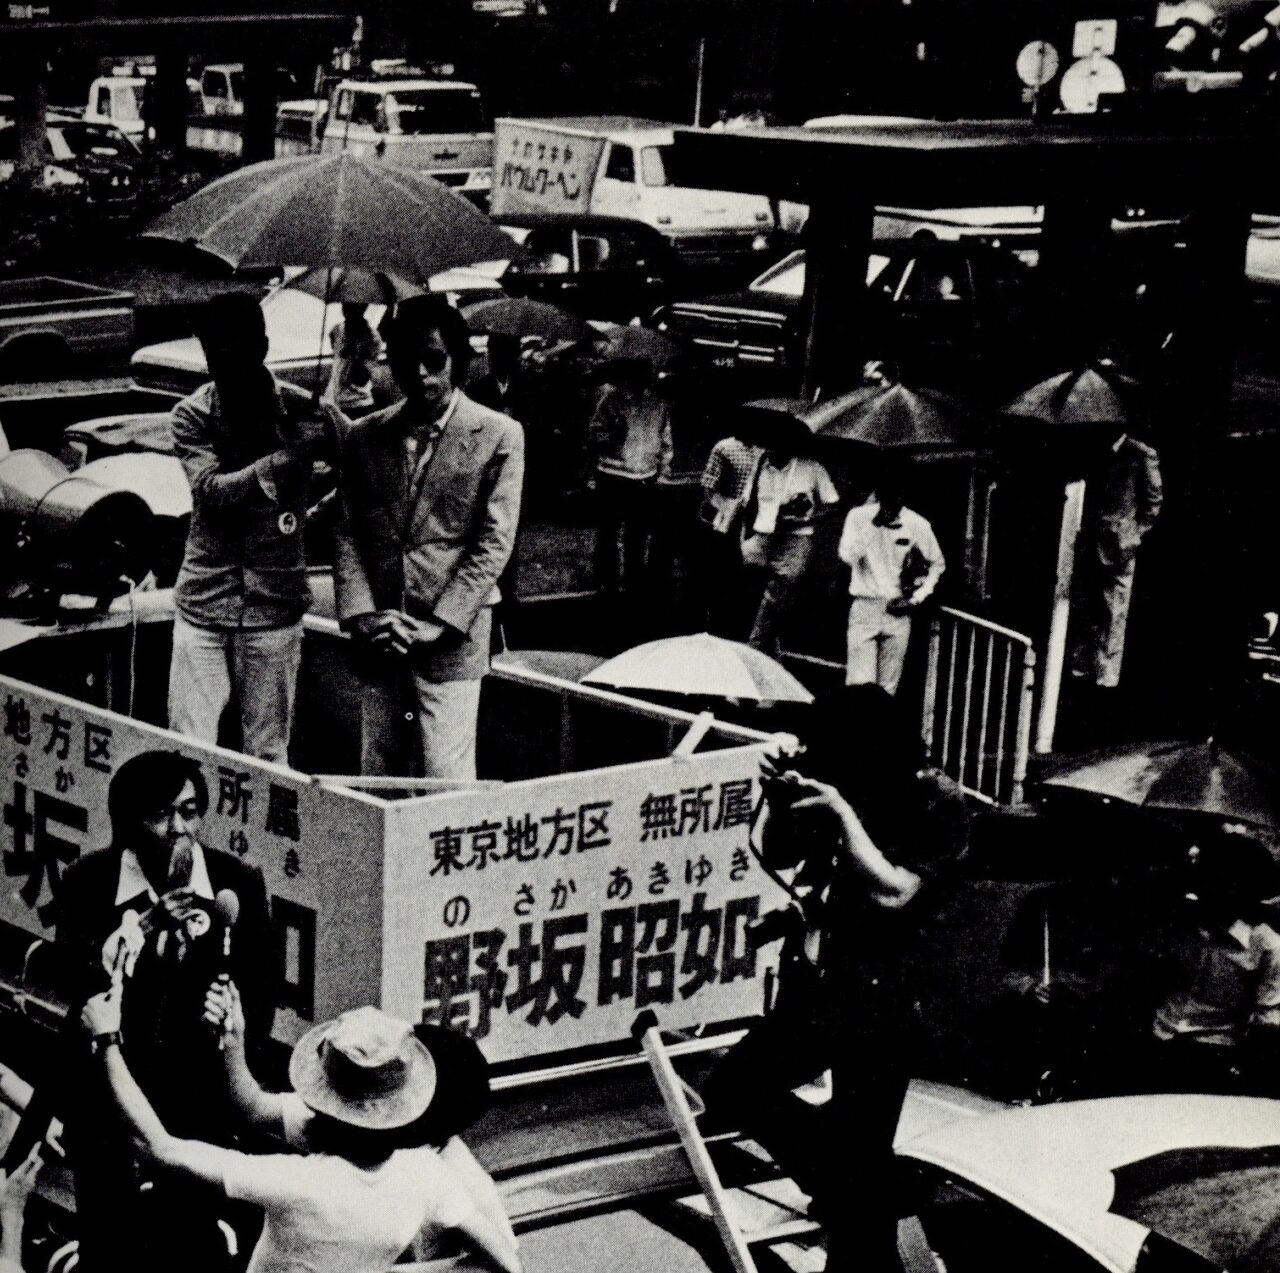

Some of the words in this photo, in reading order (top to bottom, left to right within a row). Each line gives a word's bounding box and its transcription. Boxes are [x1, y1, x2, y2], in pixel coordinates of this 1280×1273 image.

[217, 765, 301, 842] 所属
[429, 801, 613, 877] 東京地方区
[639, 778, 754, 842] 無所属
[228, 829, 301, 879] ゆき
[421, 891, 761, 1042] 野坂昭如
